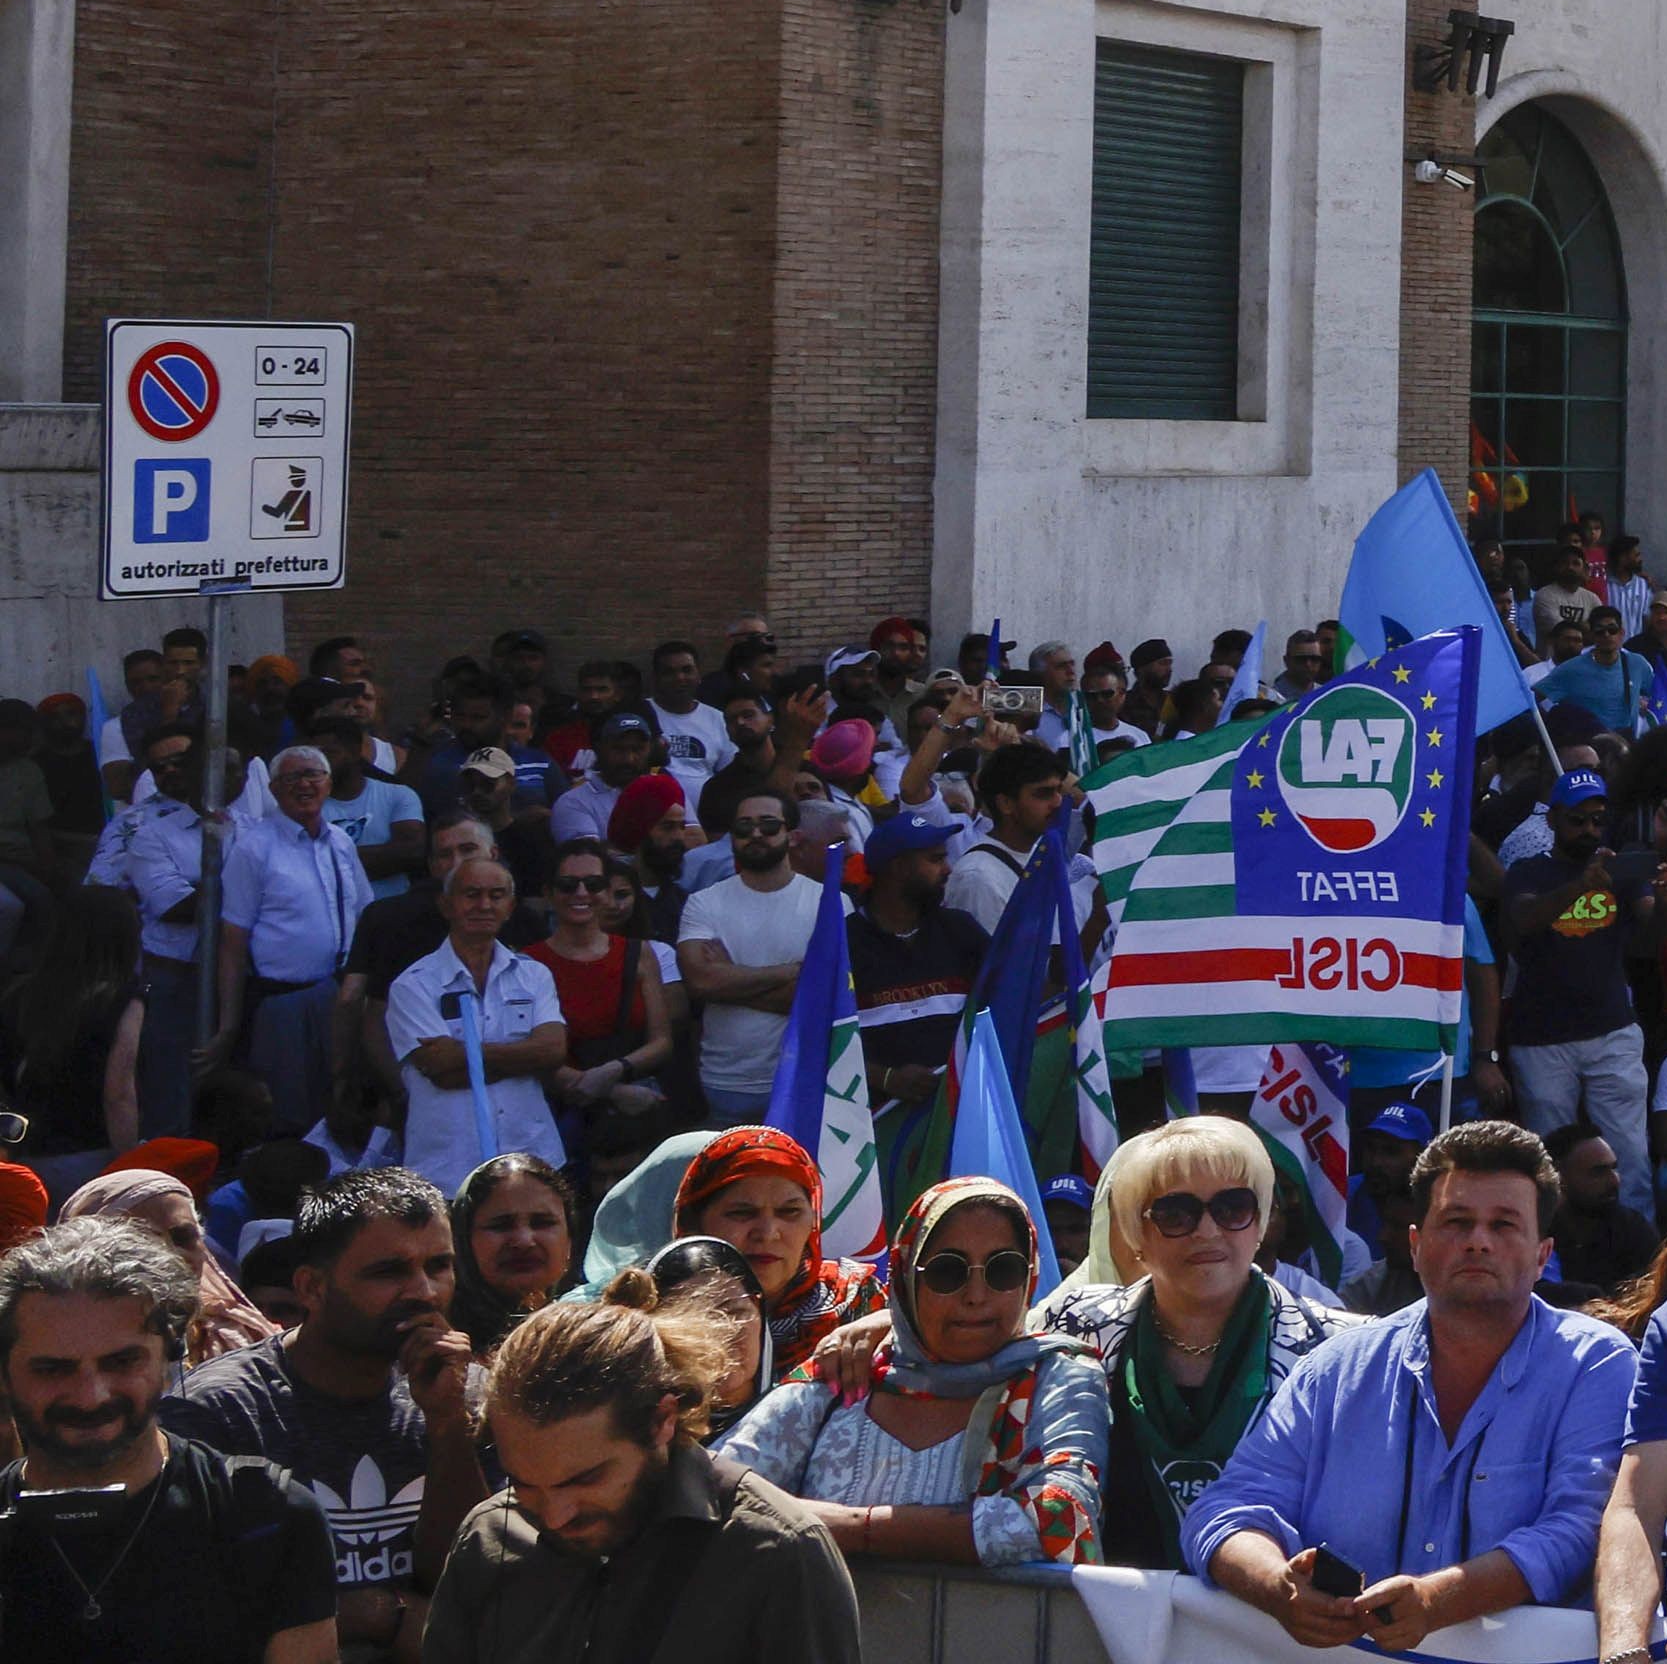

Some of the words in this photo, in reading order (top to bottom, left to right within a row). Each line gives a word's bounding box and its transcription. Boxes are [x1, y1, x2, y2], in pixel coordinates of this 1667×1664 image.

[261, 357, 276, 375] 0
[294, 357, 320, 375] 24
[152, 469, 198, 536] P
[121, 558, 225, 579] autorizzati
[234, 555, 329, 578] prefettura
[1570, 773, 1598, 785] UIL
[869, 981, 948, 1005] BROOKLYN
[1384, 1106, 1405, 1118] UIL
[1051, 1178, 1078, 1190] UIL
